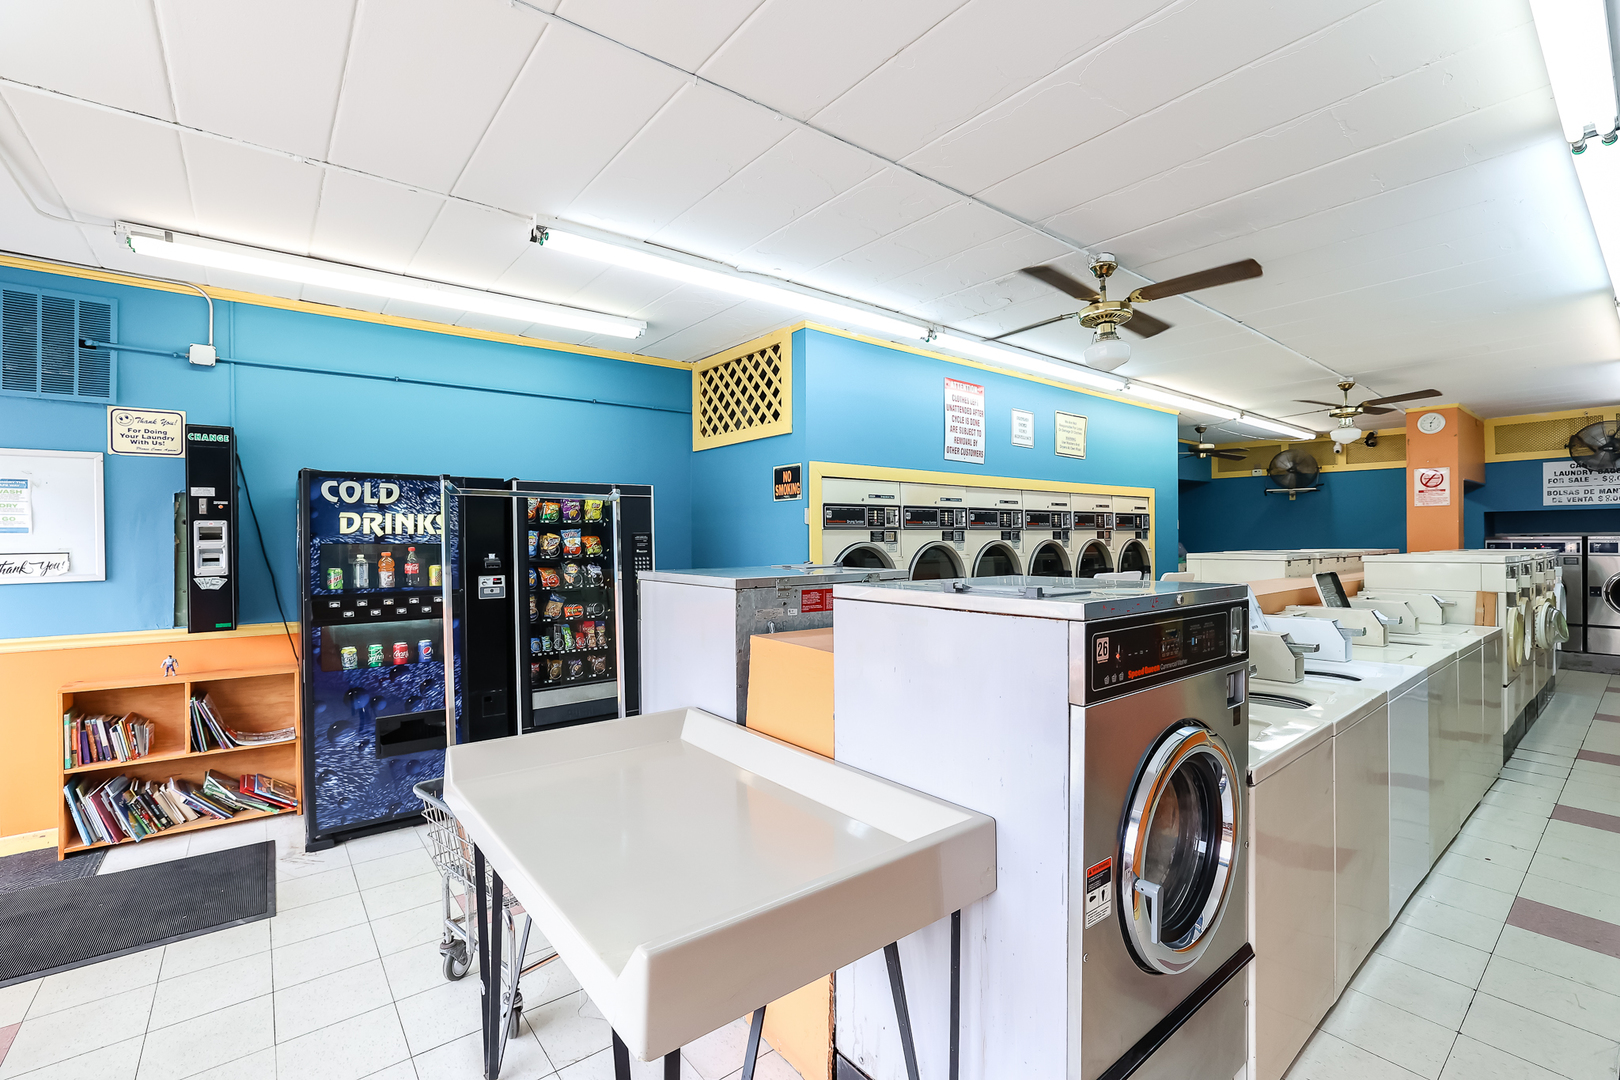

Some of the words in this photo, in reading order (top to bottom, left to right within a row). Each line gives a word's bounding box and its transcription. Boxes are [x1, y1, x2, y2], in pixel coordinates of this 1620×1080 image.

[952, 394, 969, 405] CLOTHES
[946, 403, 972, 415] UNATTENDED
[973, 408, 984, 417] AFTER
[135, 416, 157, 424] Thank
[160, 418, 178, 426] You!
[952, 415, 964, 424] CYCLE
[970, 418, 980, 427] DONE
[950, 425, 958, 434] ARE
[959, 426, 976, 436] SUBJECT
[188, 433, 229, 442] CHANGE
[954, 436, 972, 446] REMOVAL
[946, 446, 960, 454] OTHER
[961, 448, 983, 458] CUSTOMERS
[783, 470, 792, 483] NO
[321, 481, 400, 504] COLD
[775, 482, 800, 496] SMOKING
[29, 560, 65, 577] You!
[1098, 640, 1108, 657] 26
[1128, 666, 1144, 680] Speed
[1144, 664, 1161, 674] Queen
[1160, 661, 1177, 671] Commercial
